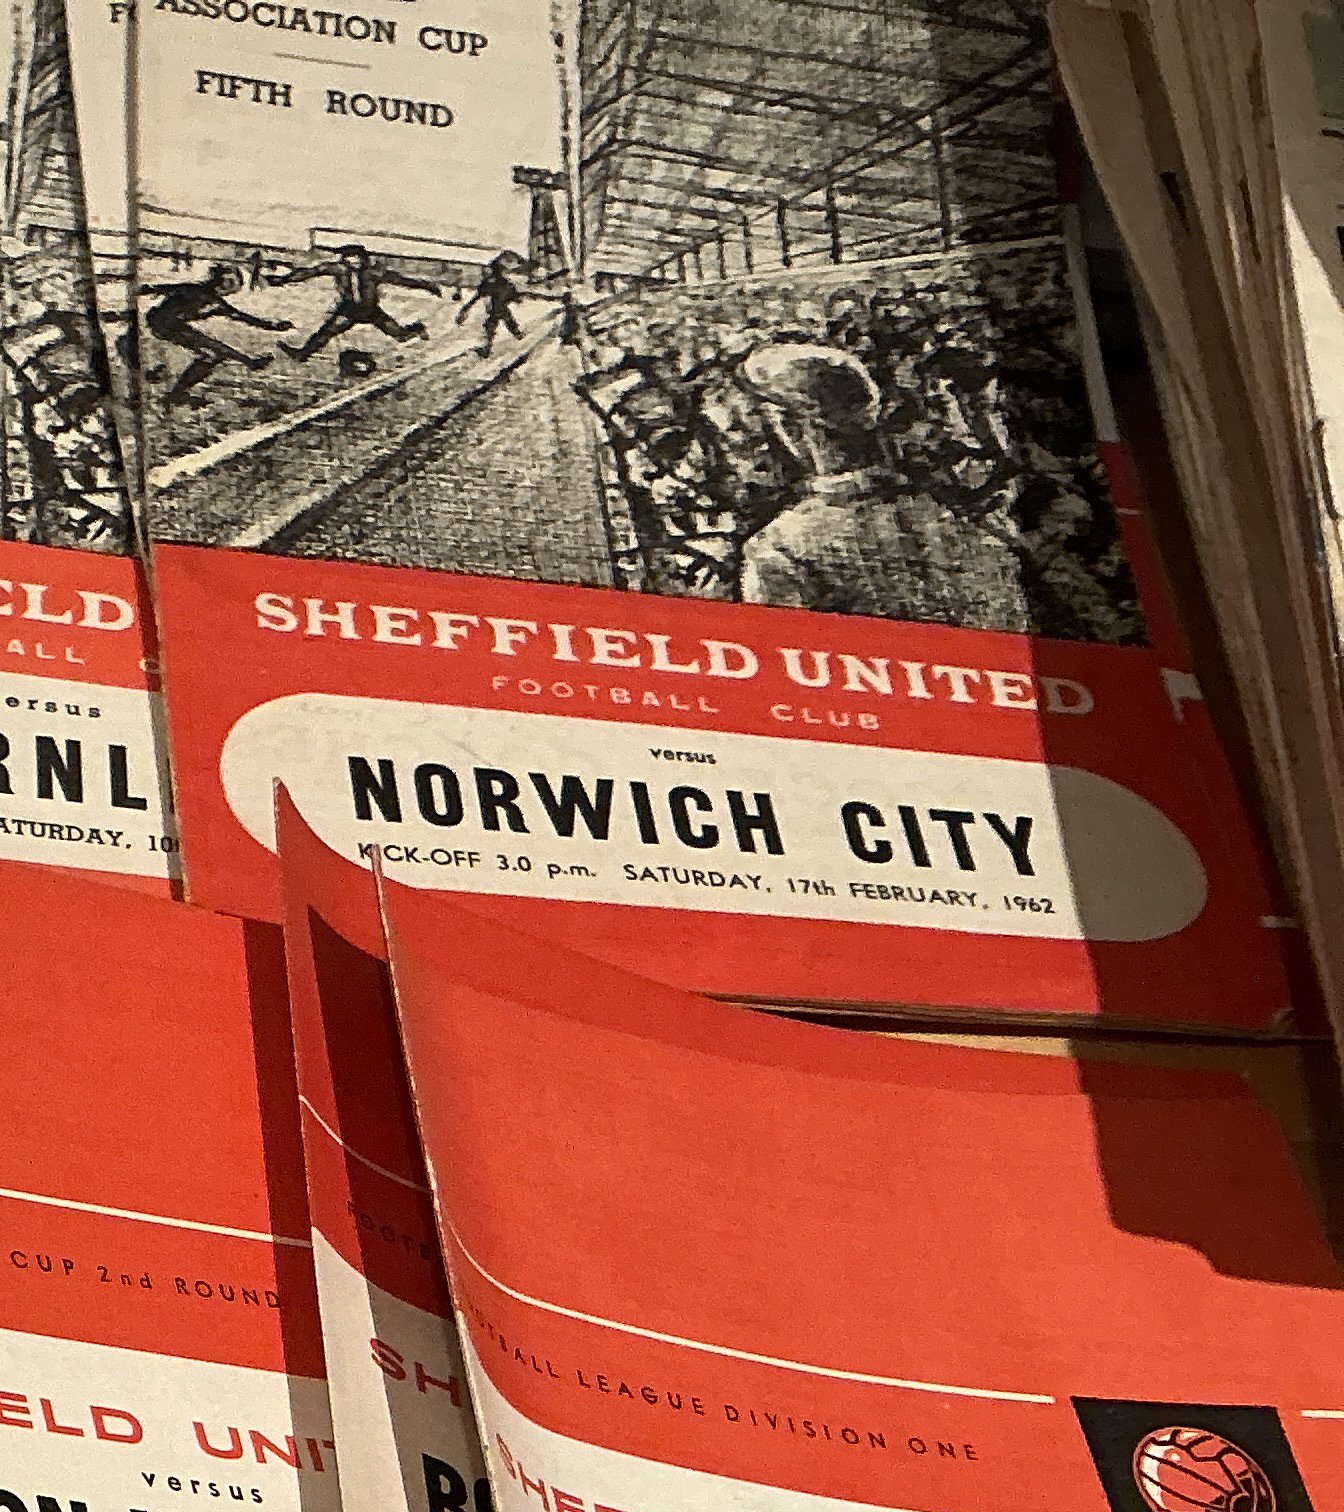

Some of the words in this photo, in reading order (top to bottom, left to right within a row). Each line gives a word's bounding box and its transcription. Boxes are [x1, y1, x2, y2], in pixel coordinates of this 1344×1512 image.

[419, 26, 488, 57] CUP
[196, 70, 292, 107] FIFTH
[326, 89, 453, 128] ROUND
[256, 592, 758, 680] SHEFFIELD
[778, 646, 1095, 715] UNITED
[491, 675, 719, 713] FOOTBALL
[770, 703, 880, 730] CLUB
[650, 748, 717, 766] versus
[348, 756, 785, 857] NORWICH
[840, 801, 1037, 877] CITY
[496, 854, 531, 873] 3.0
[548, 863, 596, 879] p.m.
[788, 879, 836, 898] 17th
[1003, 895, 1056, 914] 1962
[11, 1251, 74, 1275] CUP
[97, 1266, 152, 1289] 2nd
[175, 1277, 282, 1309] ROUND
[577, 1369, 704, 1415] LEAGUE
[724, 1404, 886, 1450] DIVISION
[907, 1436, 980, 1461] ONE
[142, 1472, 263, 1503] versus
